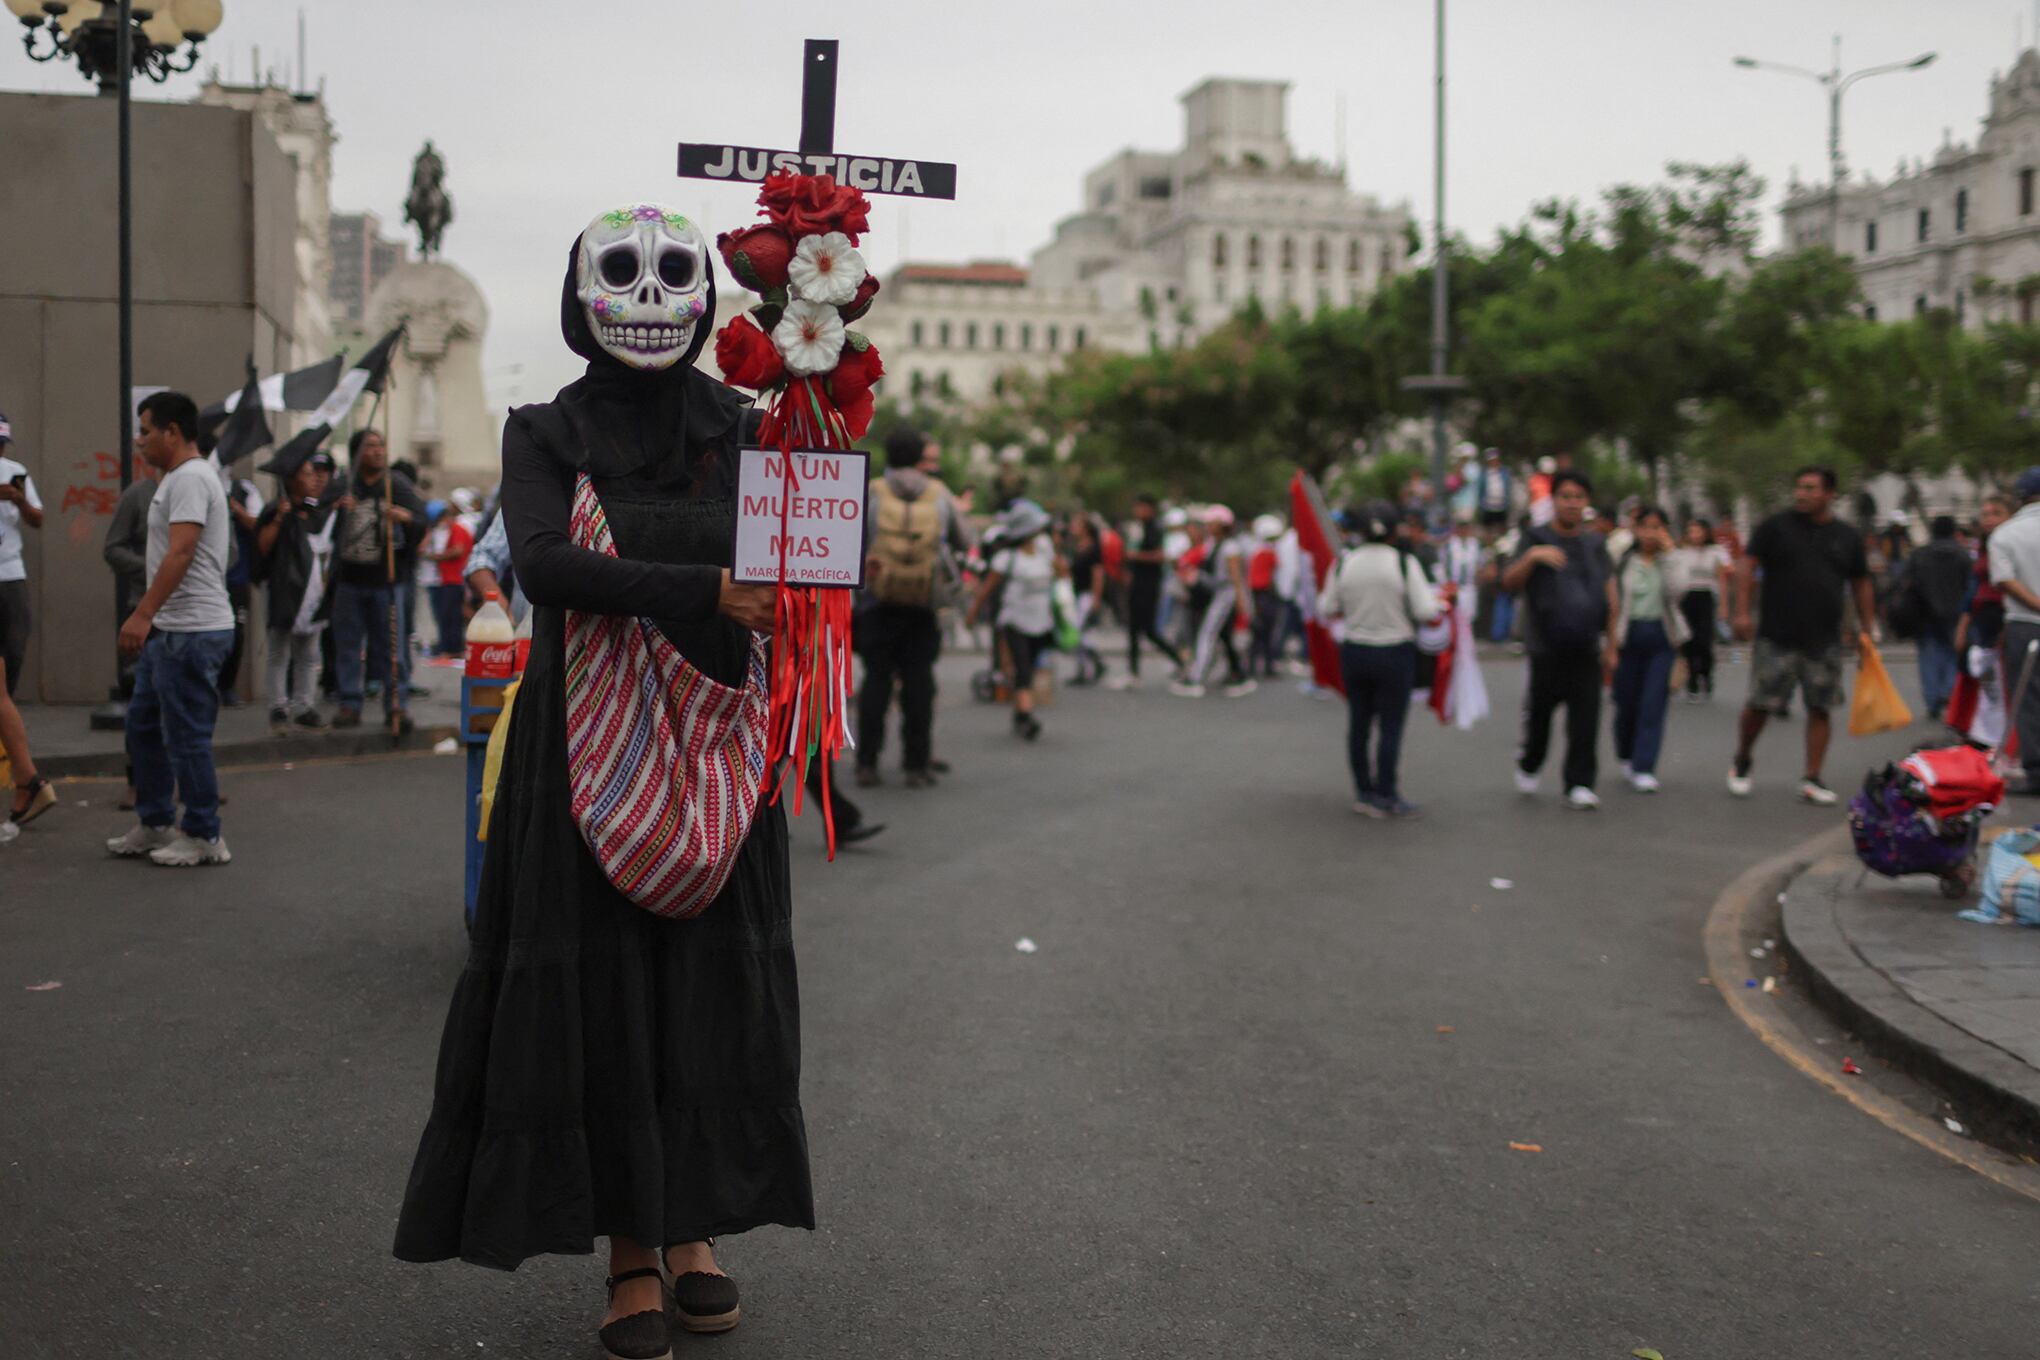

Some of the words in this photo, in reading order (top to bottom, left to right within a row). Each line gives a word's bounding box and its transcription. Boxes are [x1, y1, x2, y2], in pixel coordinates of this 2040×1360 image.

[704, 146, 924, 194] JUSTICIA
[764, 456, 789, 479] N
[801, 458, 840, 481] UN
[743, 495, 859, 521] MUERTO
[769, 534, 830, 559] MAS
[800, 567, 852, 581] PACÍFICA
